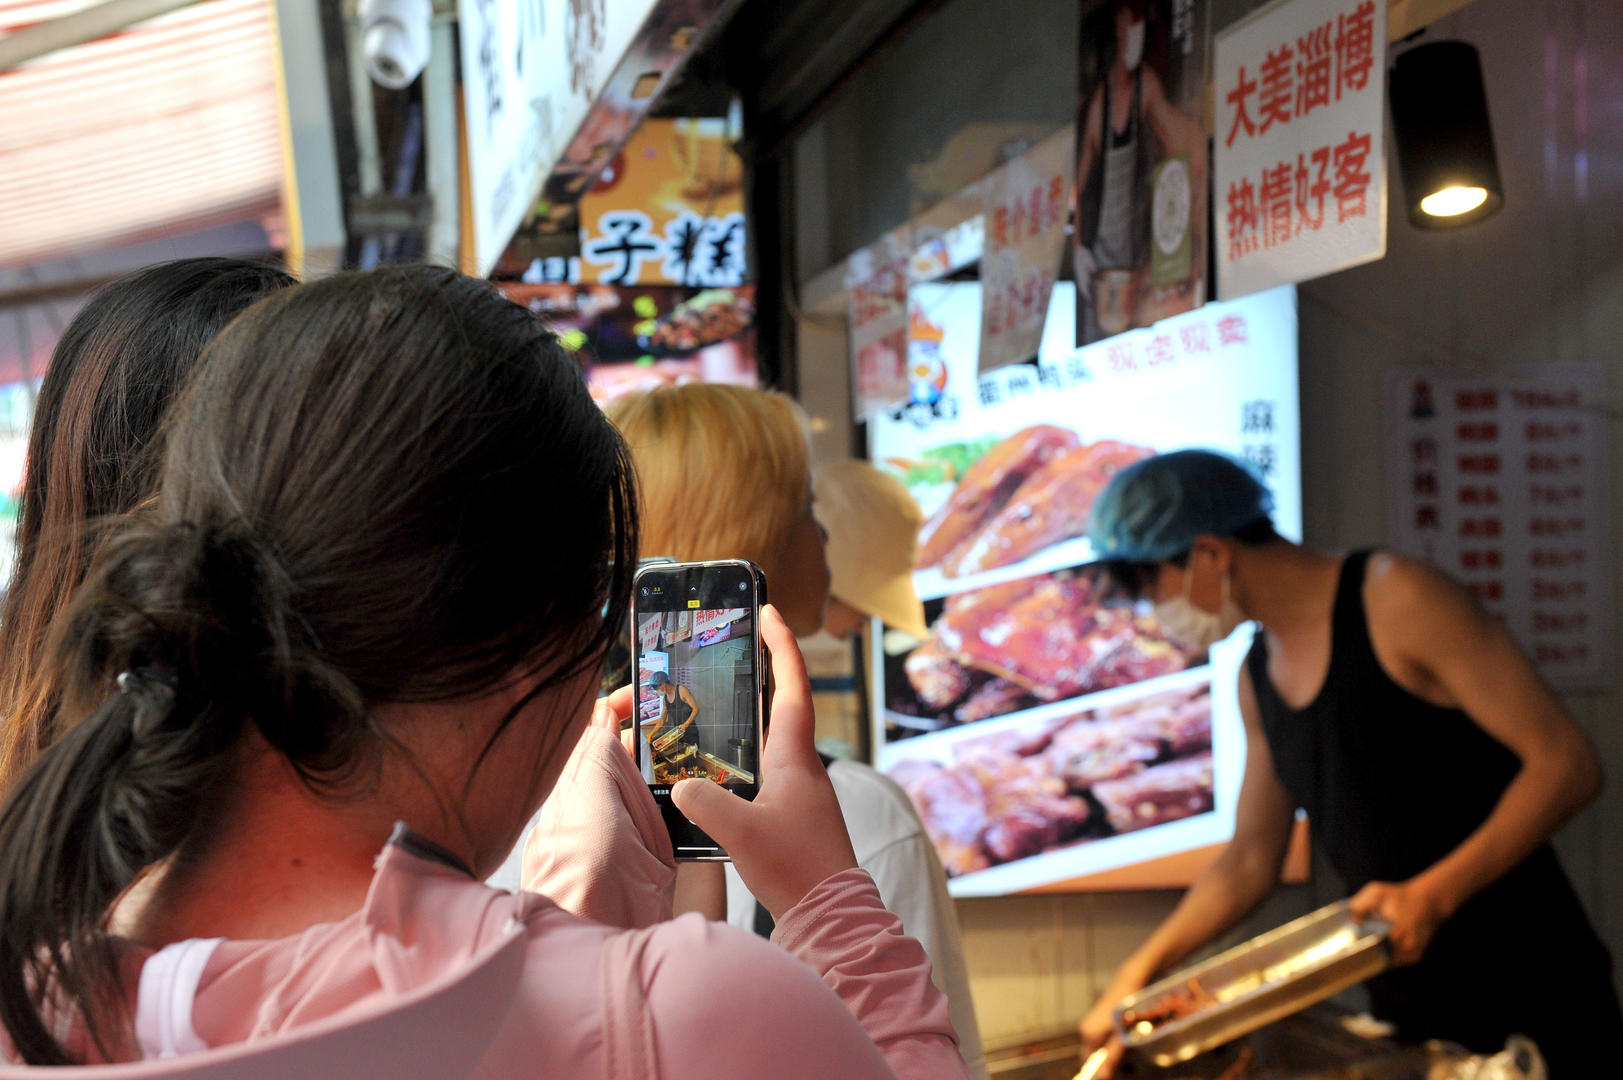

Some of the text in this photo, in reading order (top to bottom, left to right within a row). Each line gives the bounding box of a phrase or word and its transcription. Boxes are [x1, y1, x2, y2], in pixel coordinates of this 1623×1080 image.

[1225, 0, 1376, 149] 大美淄博
[522, 212, 746, 286] 子糕
[1226, 130, 1372, 262] 热情好客
